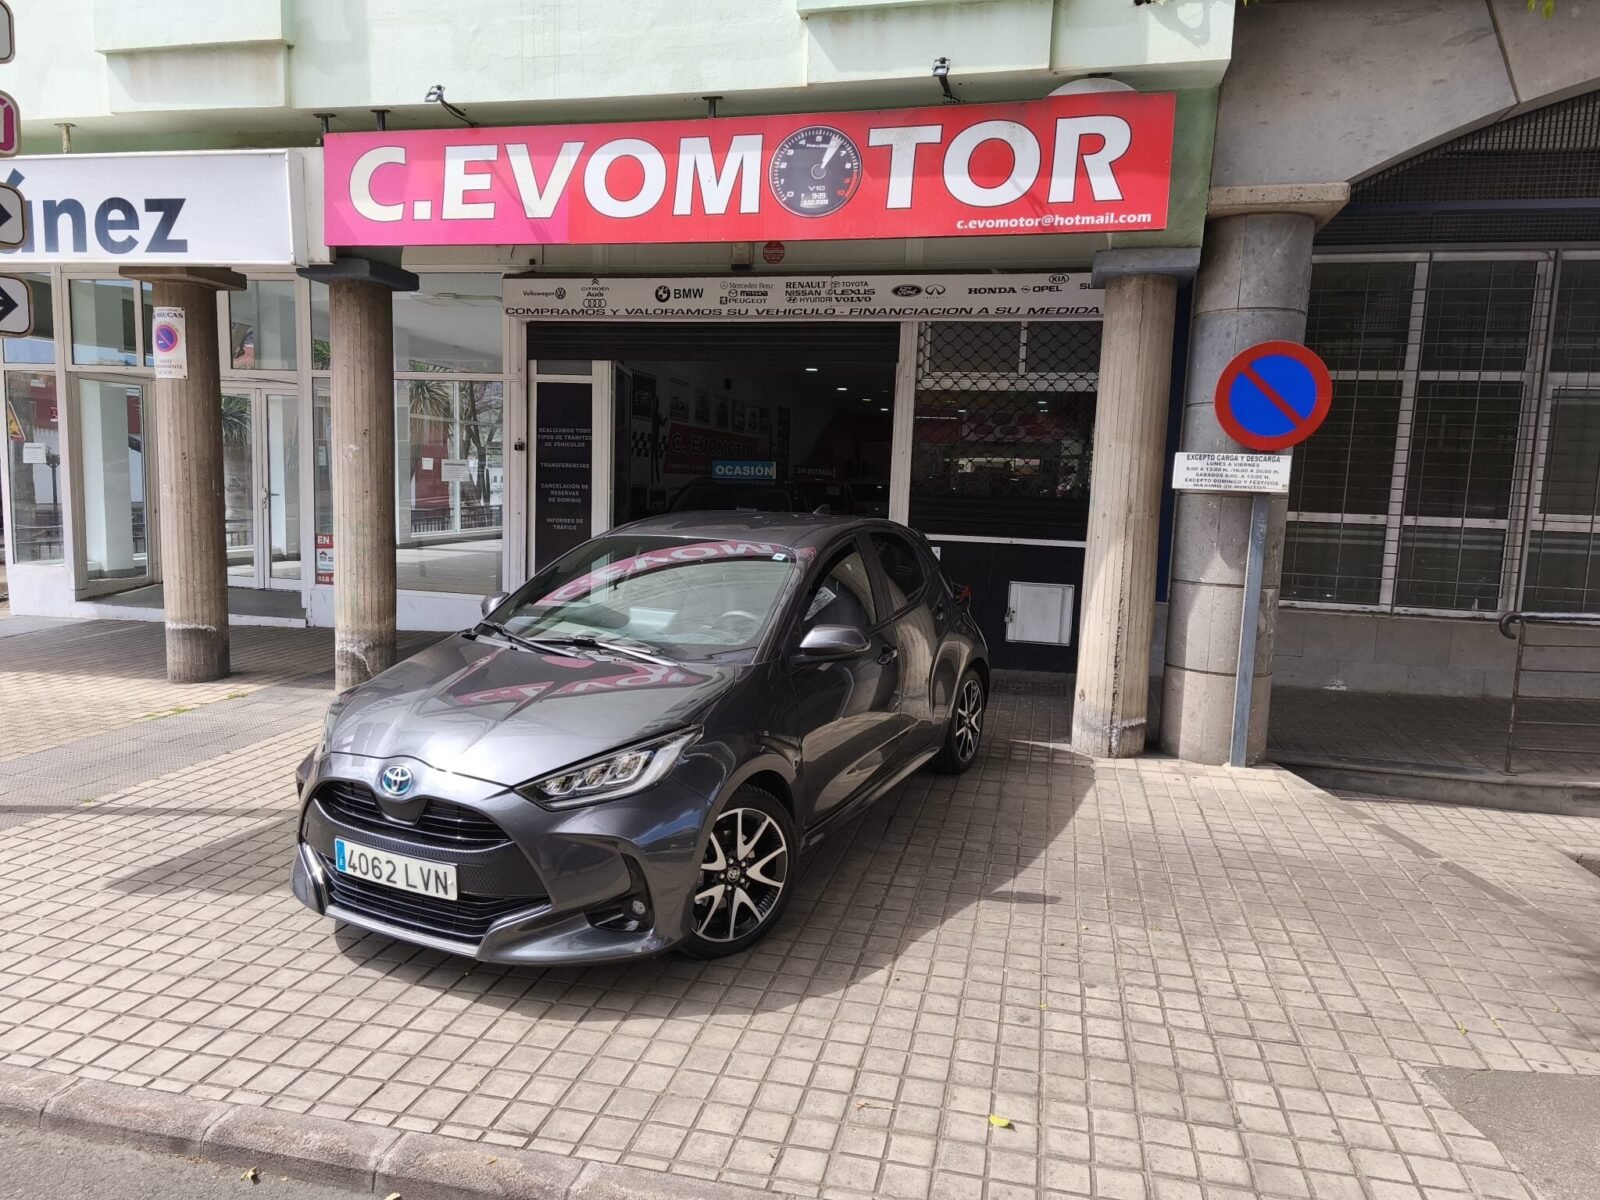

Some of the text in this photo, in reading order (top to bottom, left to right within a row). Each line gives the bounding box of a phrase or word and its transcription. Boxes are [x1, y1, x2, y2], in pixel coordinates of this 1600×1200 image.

[956, 211, 1152, 230] c.evomotor@hotmail.com
[785, 281, 828, 289] RENAULT
[1032, 285, 1063, 293] OPEL
[673, 288, 704, 299] BMW
[785, 289, 822, 297] NISSAN
[833, 288, 875, 296] LEXUS
[967, 287, 1017, 295] HONDA
[505, 307, 605, 316] COMPRAMOS
[625, 308, 722, 316] VALORAMOS
[727, 308, 749, 316] SU
[849, 306, 973, 316] FINANCIACION
[977, 307, 989, 315] A
[995, 307, 1021, 315] SU
[1027, 306, 1100, 315] MEDIDA
[1186, 453, 1215, 461] EXCEPTO
[1246, 455, 1281, 463] DESCARGA
[715, 463, 773, 476] OCASIÓN
[317, 535, 330, 545] EN
[347, 849, 449, 896] 4062 LVN
